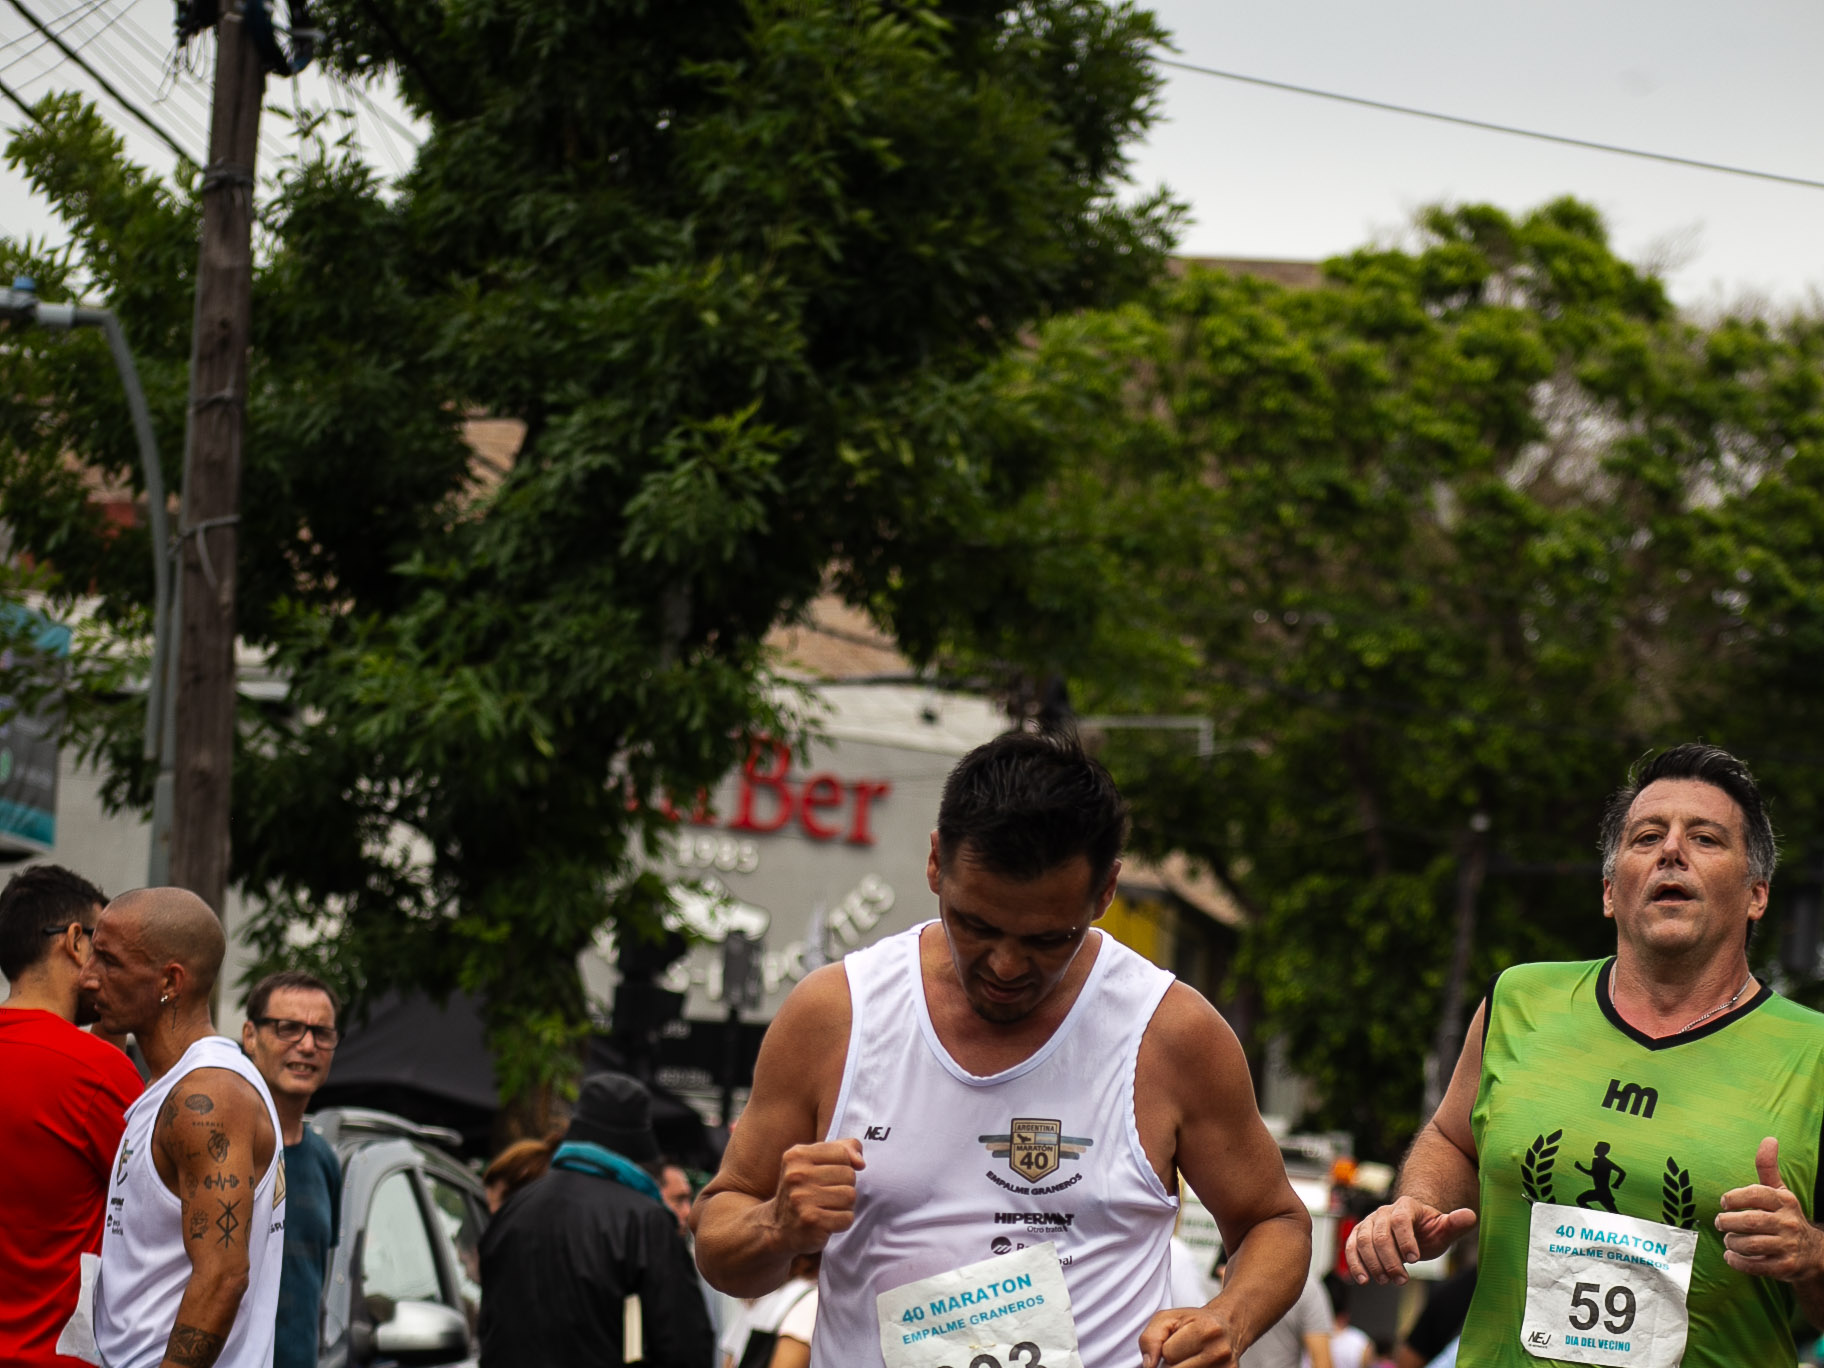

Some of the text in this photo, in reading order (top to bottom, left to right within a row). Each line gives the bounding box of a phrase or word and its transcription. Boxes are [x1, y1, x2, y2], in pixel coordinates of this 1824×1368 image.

[864, 1126, 891, 1141] NEJ
[1016, 1124, 1055, 1132] ARGENTINA
[1016, 1144, 1053, 1152] MARATÓN
[1020, 1152, 1049, 1170] 40
[986, 1171, 1082, 1196] EMPALME GRANEROS
[1556, 1224, 1668, 1257] 40 MARATON
[1549, 1244, 1604, 1259] EMPALME
[902, 1273, 1032, 1324] 40 MARATON
[1568, 1281, 1637, 1335] 59
[903, 1295, 1045, 1345] EMPALME GRANEROS
[1528, 1331, 1551, 1345] NEJ
[1565, 1335, 1631, 1352] DIA DEL VECINO
